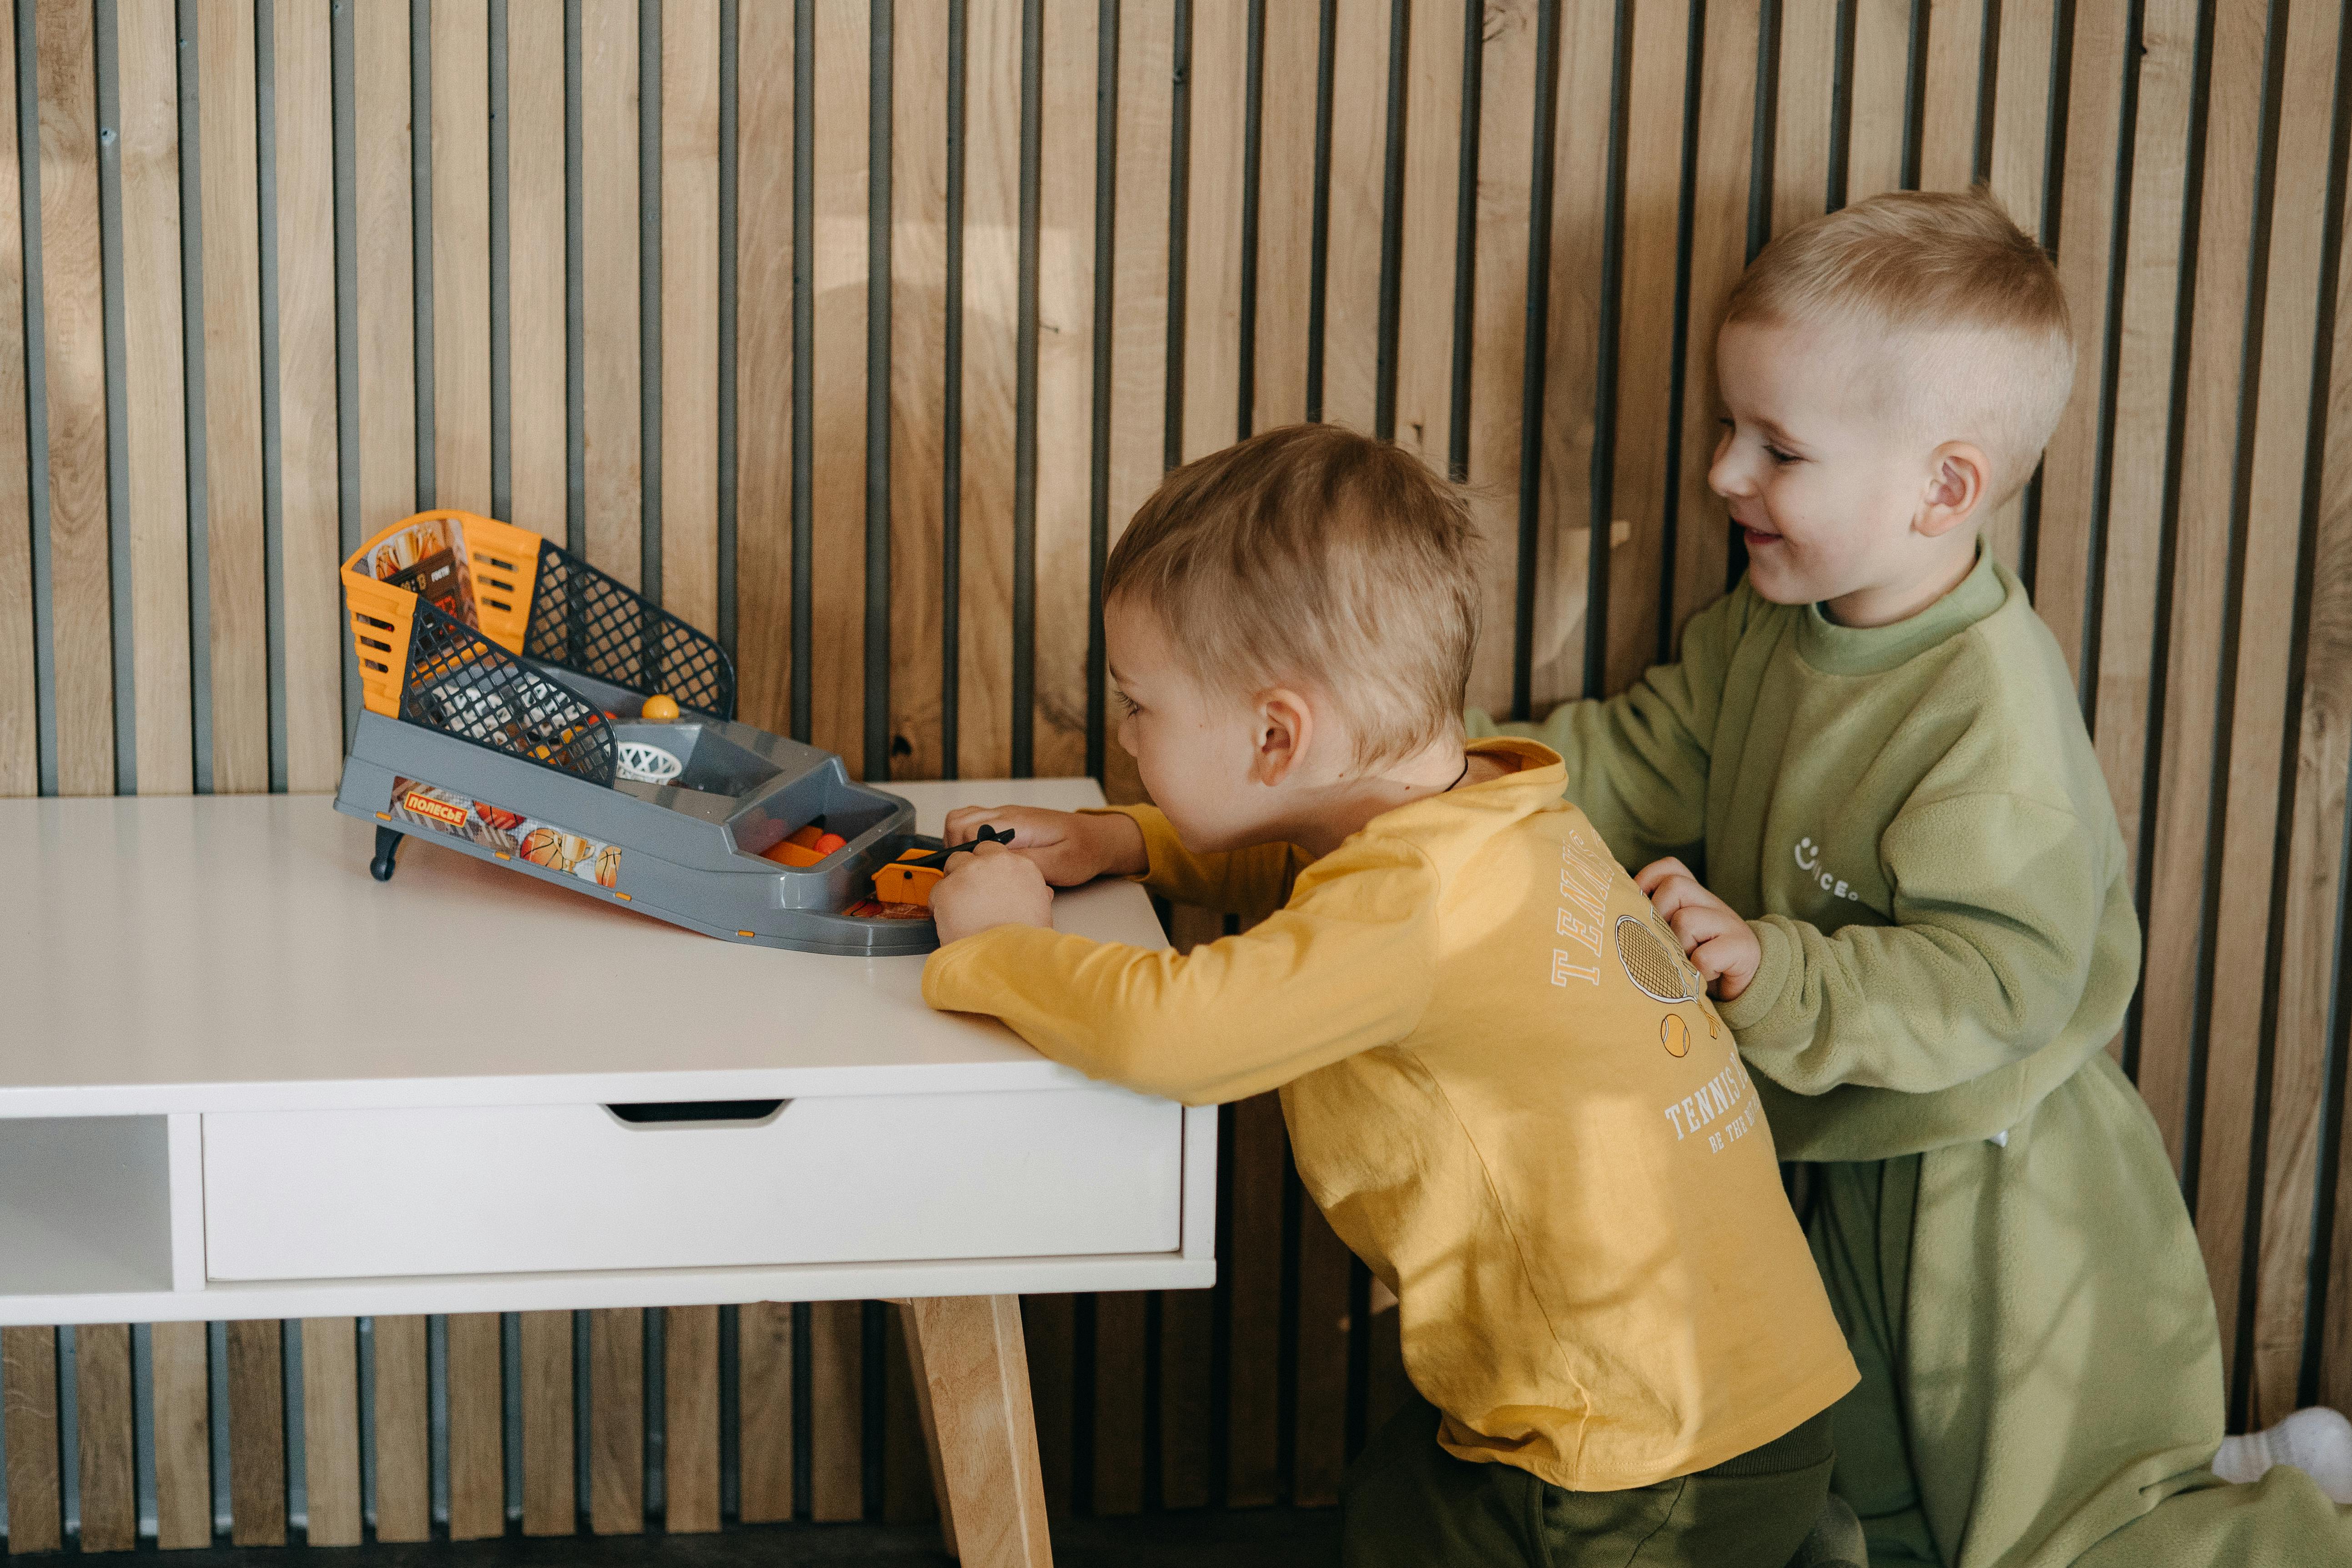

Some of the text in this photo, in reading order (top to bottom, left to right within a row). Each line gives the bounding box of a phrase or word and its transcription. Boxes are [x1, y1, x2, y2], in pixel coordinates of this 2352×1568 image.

[409, 796, 463, 823] ПОЛЕСЬЕ
[1664, 1066, 1740, 1141] TENNIS
[1708, 1116, 1748, 1154] BE THE
